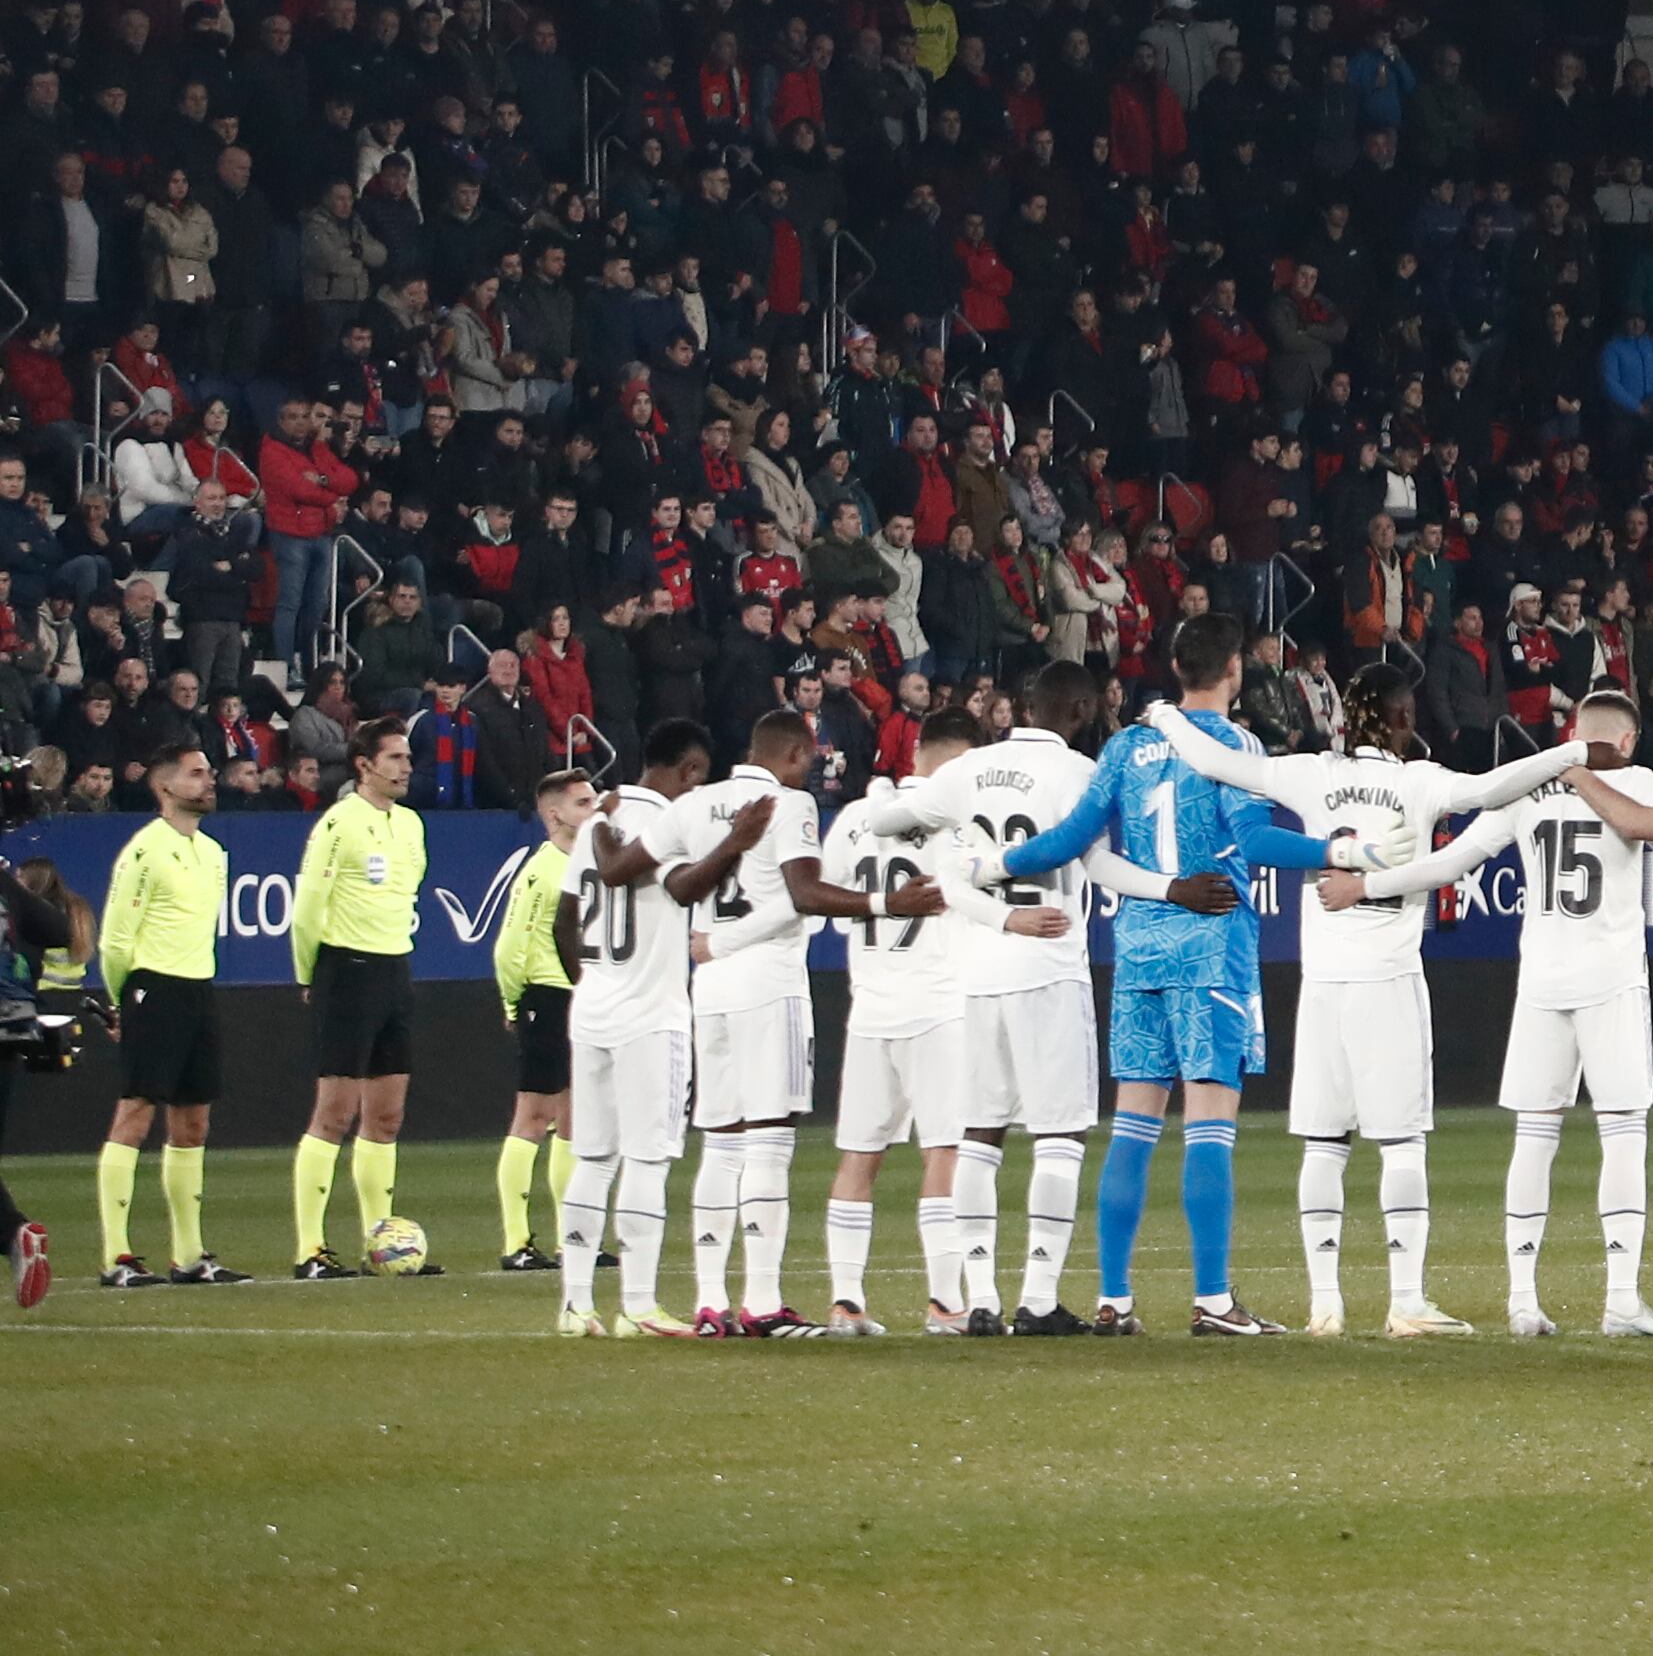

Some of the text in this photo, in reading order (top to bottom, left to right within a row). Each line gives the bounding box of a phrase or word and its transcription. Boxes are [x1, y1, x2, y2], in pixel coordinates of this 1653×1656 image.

[976, 767, 1035, 796] RÜDIGER
[1143, 780, 1179, 875] 1
[579, 868, 637, 965] 20
[1530, 819, 1604, 919] 15
